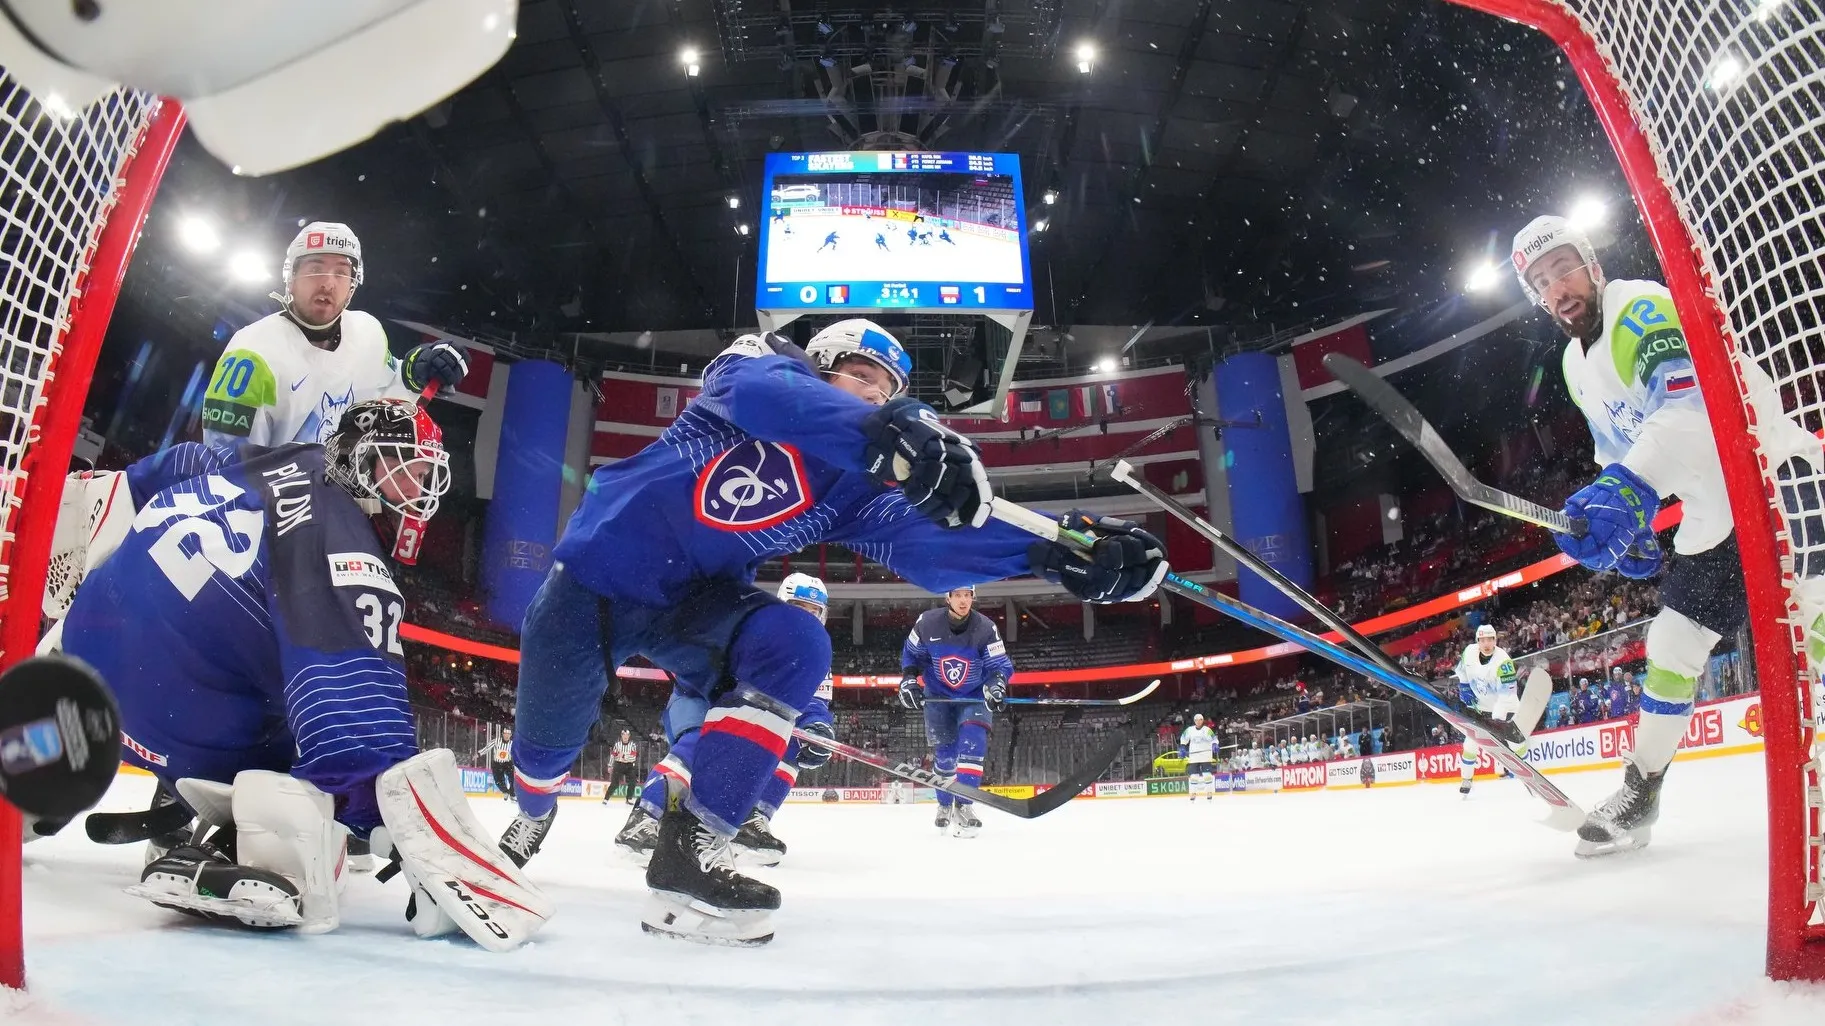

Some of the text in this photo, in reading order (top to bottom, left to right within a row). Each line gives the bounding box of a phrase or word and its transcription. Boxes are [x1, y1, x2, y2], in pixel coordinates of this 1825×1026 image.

[326, 236, 356, 249] triglav
[1523, 232, 1554, 255] triglav
[800, 285, 818, 304] 0
[881, 287, 919, 299] 3:41
[973, 286, 986, 304] 1
[1619, 299, 1669, 337] 12
[213, 356, 255, 399] 70
[261, 462, 313, 537] PILON
[1596, 475, 1647, 529] CCM
[363, 561, 391, 579] TIS
[1166, 572, 1204, 593] AUER
[355, 592, 405, 658] 32
[1500, 662, 1513, 674] 96
[1602, 711, 1722, 756] BAUS
[1336, 766, 1358, 776] TISSOT
[1387, 760, 1412, 771] TISSOT
[1430, 749, 1491, 774] STRASS
[894, 763, 957, 789] CCM
[1283, 765, 1325, 787] PATRON
[844, 790, 884, 800] BAUHA
[993, 787, 1025, 796] Raiffeisen
[1098, 784, 1121, 792] UNIBET
[1124, 783, 1144, 791] UNIBET
[444, 880, 509, 940] CCM
